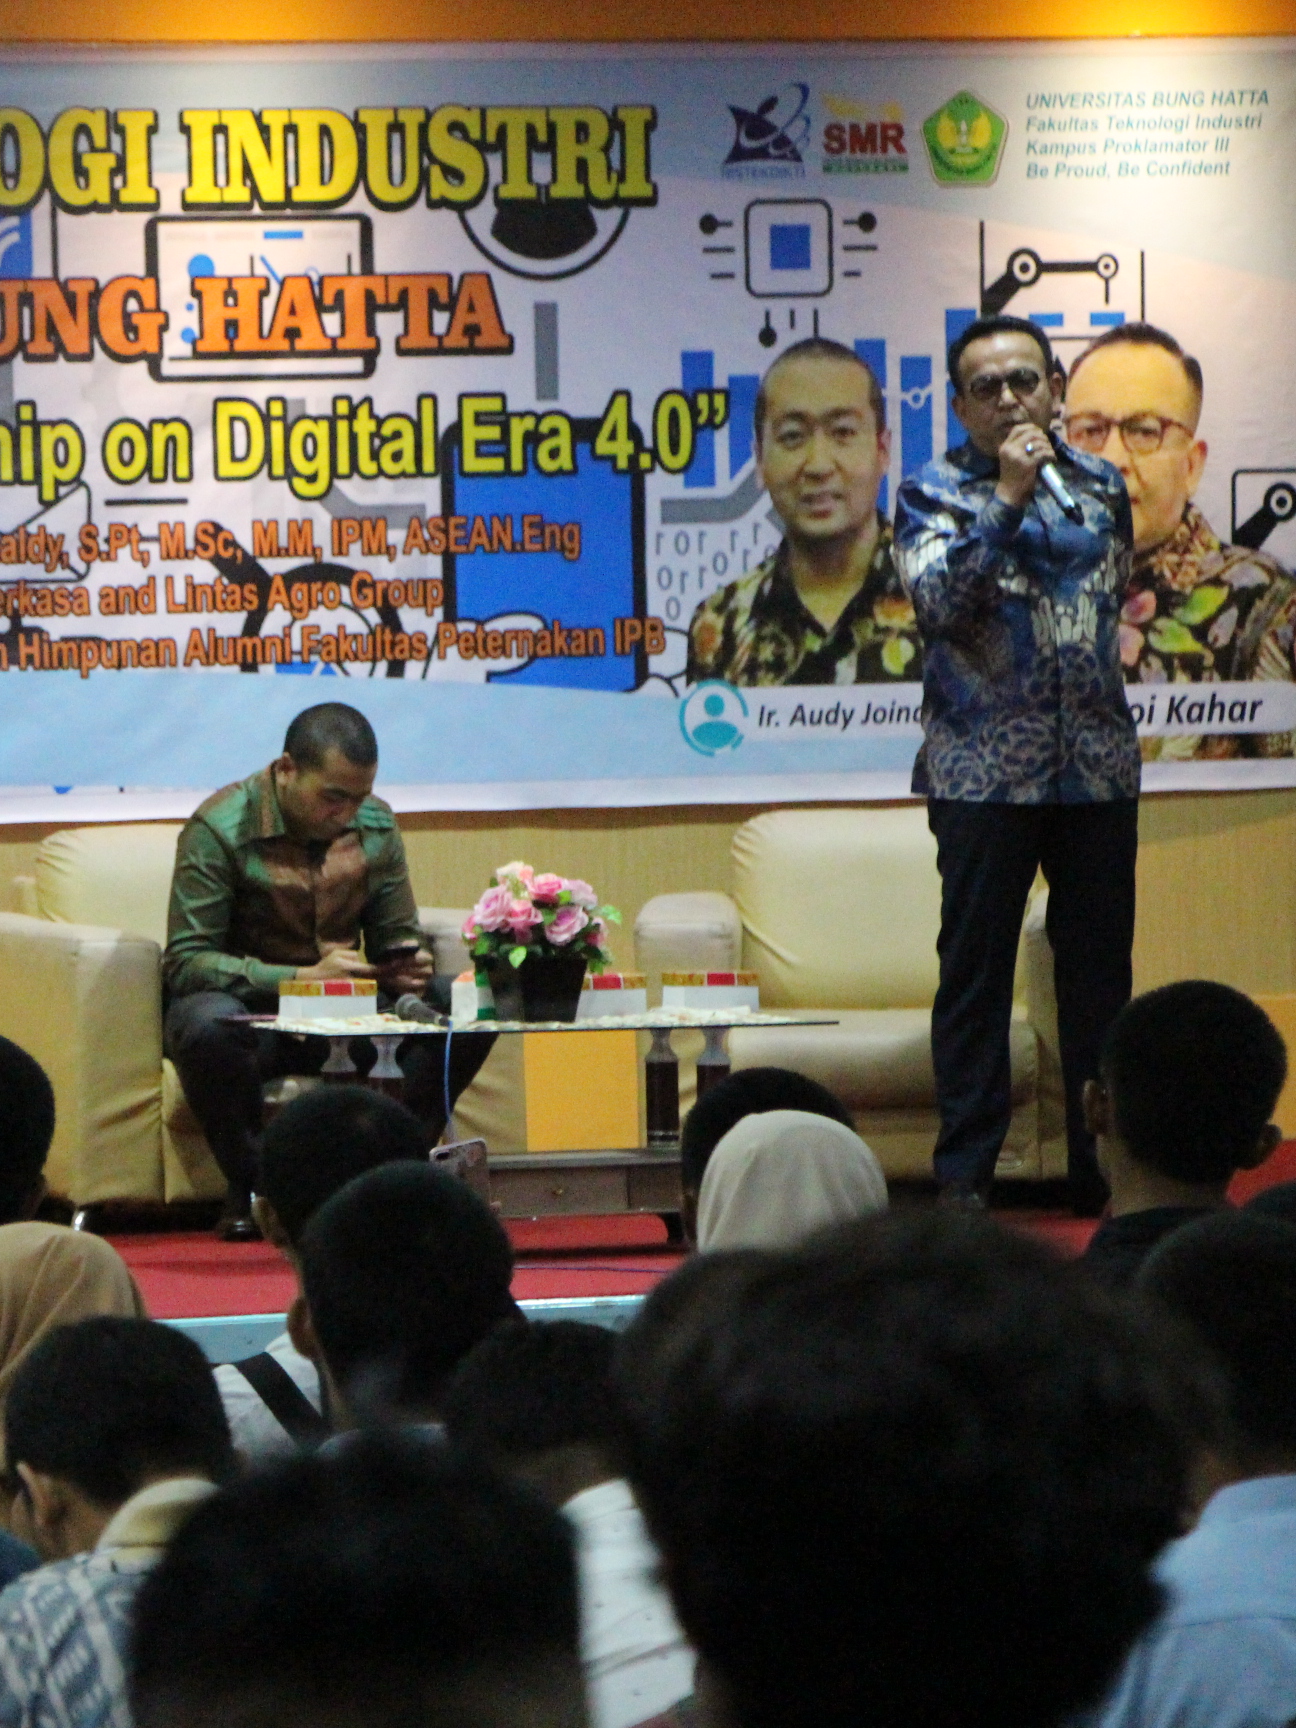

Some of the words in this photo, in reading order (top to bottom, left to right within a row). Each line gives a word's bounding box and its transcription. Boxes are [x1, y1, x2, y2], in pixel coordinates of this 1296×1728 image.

[1026, 91, 1146, 109] UNIVERSITAS
[1152, 90, 1204, 108] BUNG
[1211, 89, 1269, 106] HATTA
[823, 122, 907, 155] SMR
[1026, 115, 1099, 132] Fakultas
[1107, 114, 1189, 133] Teknologi
[1195, 112, 1262, 130] Industri
[181, 103, 657, 209] INDUSTRI
[1026, 139, 1097, 161] Kampus
[1103, 137, 1209, 154] Proklamator
[1026, 162, 1049, 178] Be
[1054, 161, 1111, 179] Proud,
[1117, 161, 1140, 177] Be
[1147, 160, 1231, 177] Confident
[193, 272, 513, 357] HATTA
[104, 417, 194, 482] on
[212, 393, 440, 500] Digital
[457, 393, 576, 475] Era
[78, 523, 150, 568] S.Pt,
[159, 520, 243, 564] M.Sc,
[252, 518, 322, 562] M.M,
[331, 517, 397, 561] IPM,
[405, 514, 581, 561] ASEAN.Eng
[99, 576, 156, 615] and
[166, 572, 258, 614] Lintas
[267, 573, 341, 620] Agro
[350, 571, 444, 616] Group
[17, 632, 176, 679] Himpunan
[184, 626, 292, 670] Alumni
[303, 623, 428, 664] Fakultas
[438, 621, 604, 660] Peternakan
[614, 616, 666, 656] IPB
[758, 704, 780, 728] Ir.
[791, 703, 855, 731] Audy
[1166, 693, 1263, 726] Kahar
